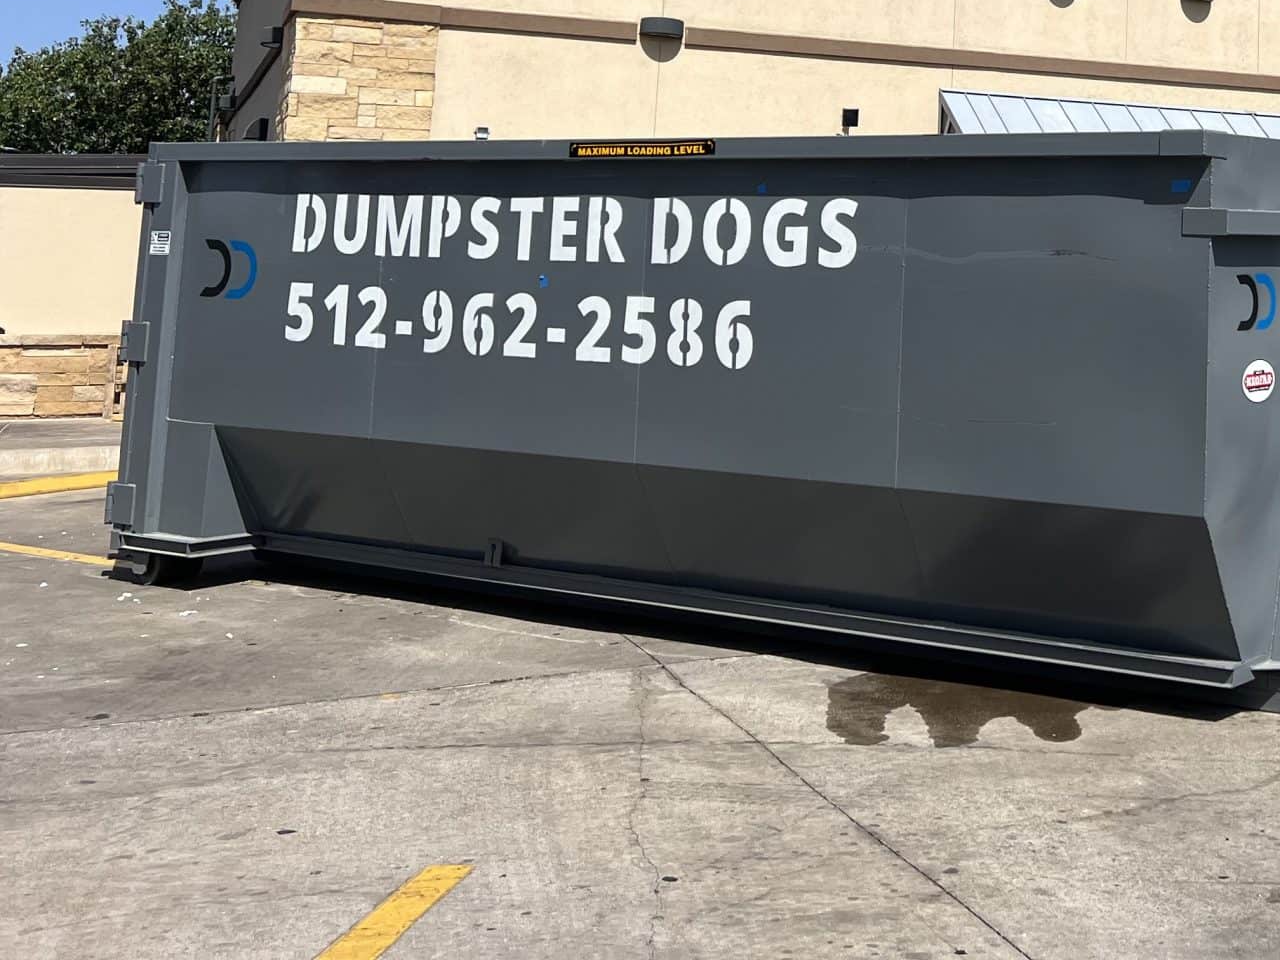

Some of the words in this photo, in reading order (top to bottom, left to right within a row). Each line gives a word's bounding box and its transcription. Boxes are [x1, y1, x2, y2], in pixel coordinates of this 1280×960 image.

[577, 147, 625, 156] MAXIMUM
[627, 146, 672, 156] LOADING
[674, 145, 705, 154] LEVEL
[292, 193, 626, 263] DUMPSTER
[651, 197, 859, 269] DOGS
[284, 282, 754, 370] 512-962-2586
